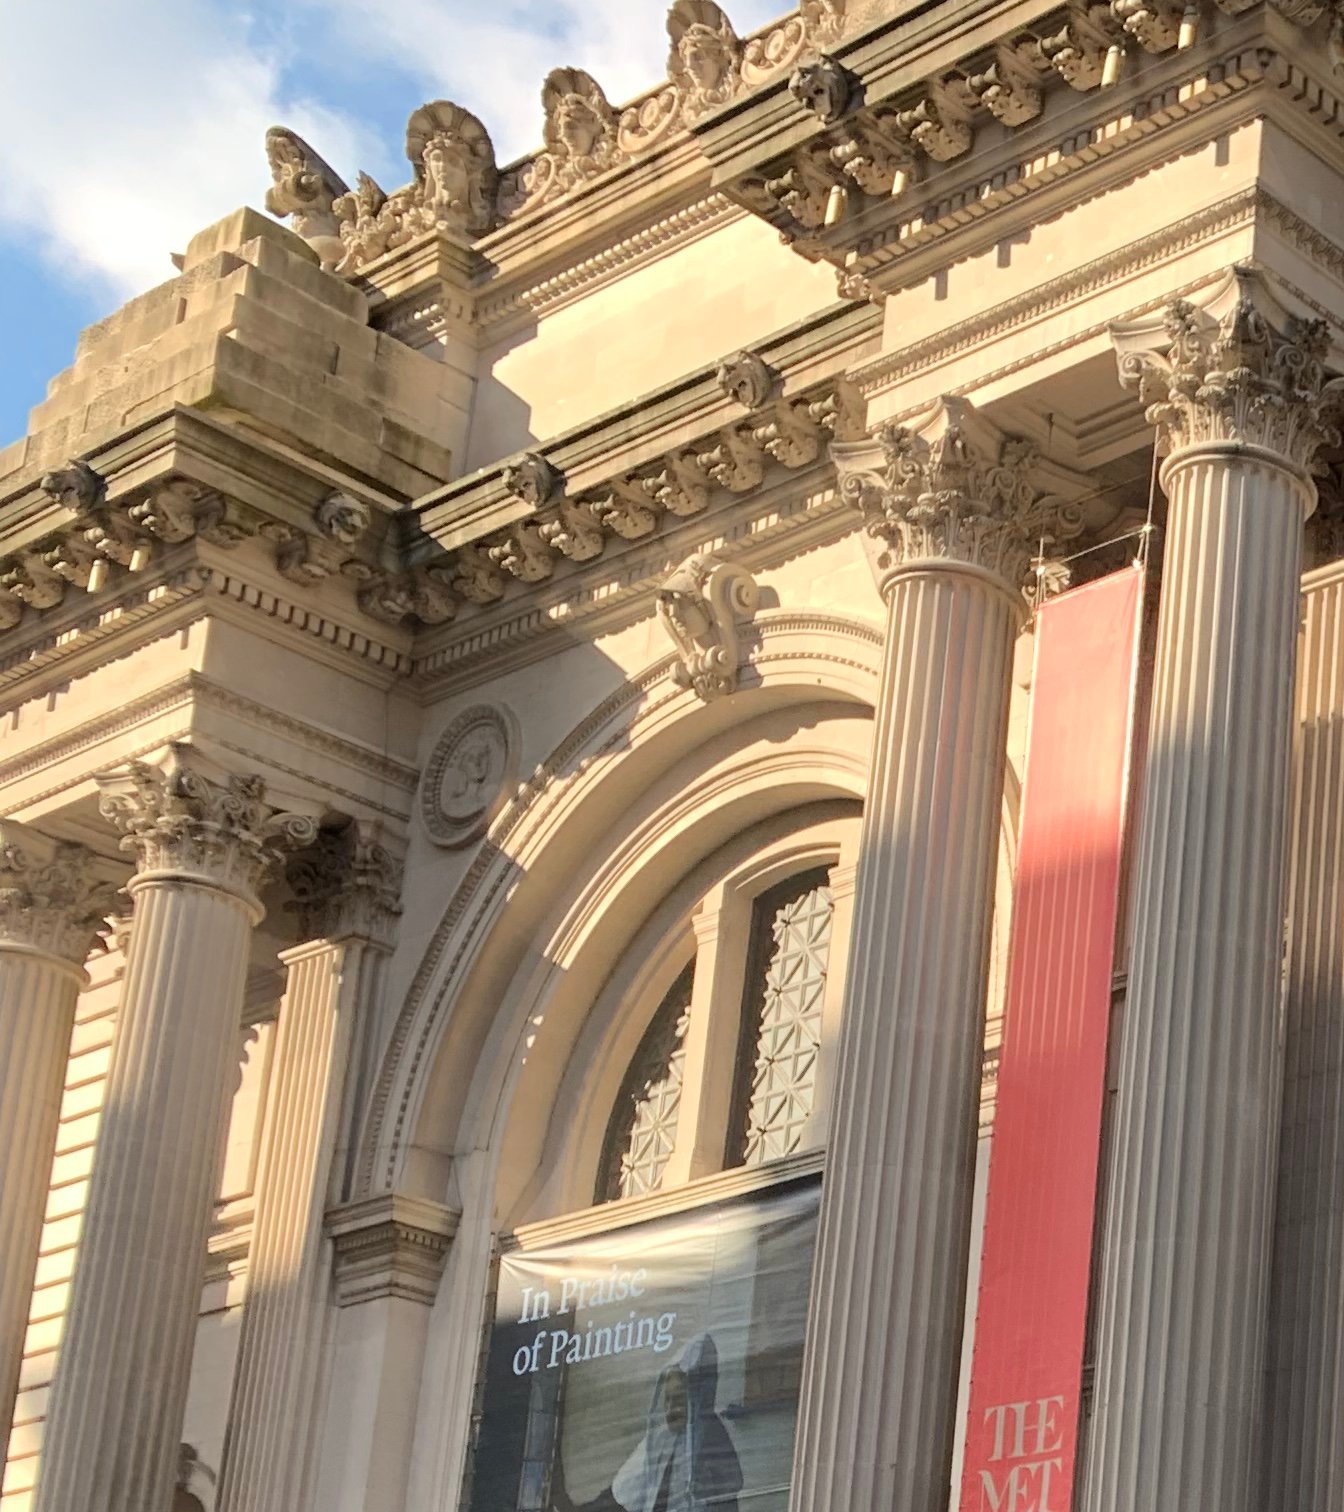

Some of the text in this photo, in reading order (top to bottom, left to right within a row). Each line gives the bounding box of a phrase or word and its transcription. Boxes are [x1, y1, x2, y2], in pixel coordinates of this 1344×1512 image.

[517, 1264, 647, 1324] In Praise
[512, 1311, 677, 1376] of Painting
[983, 1395, 1065, 1462] THE
